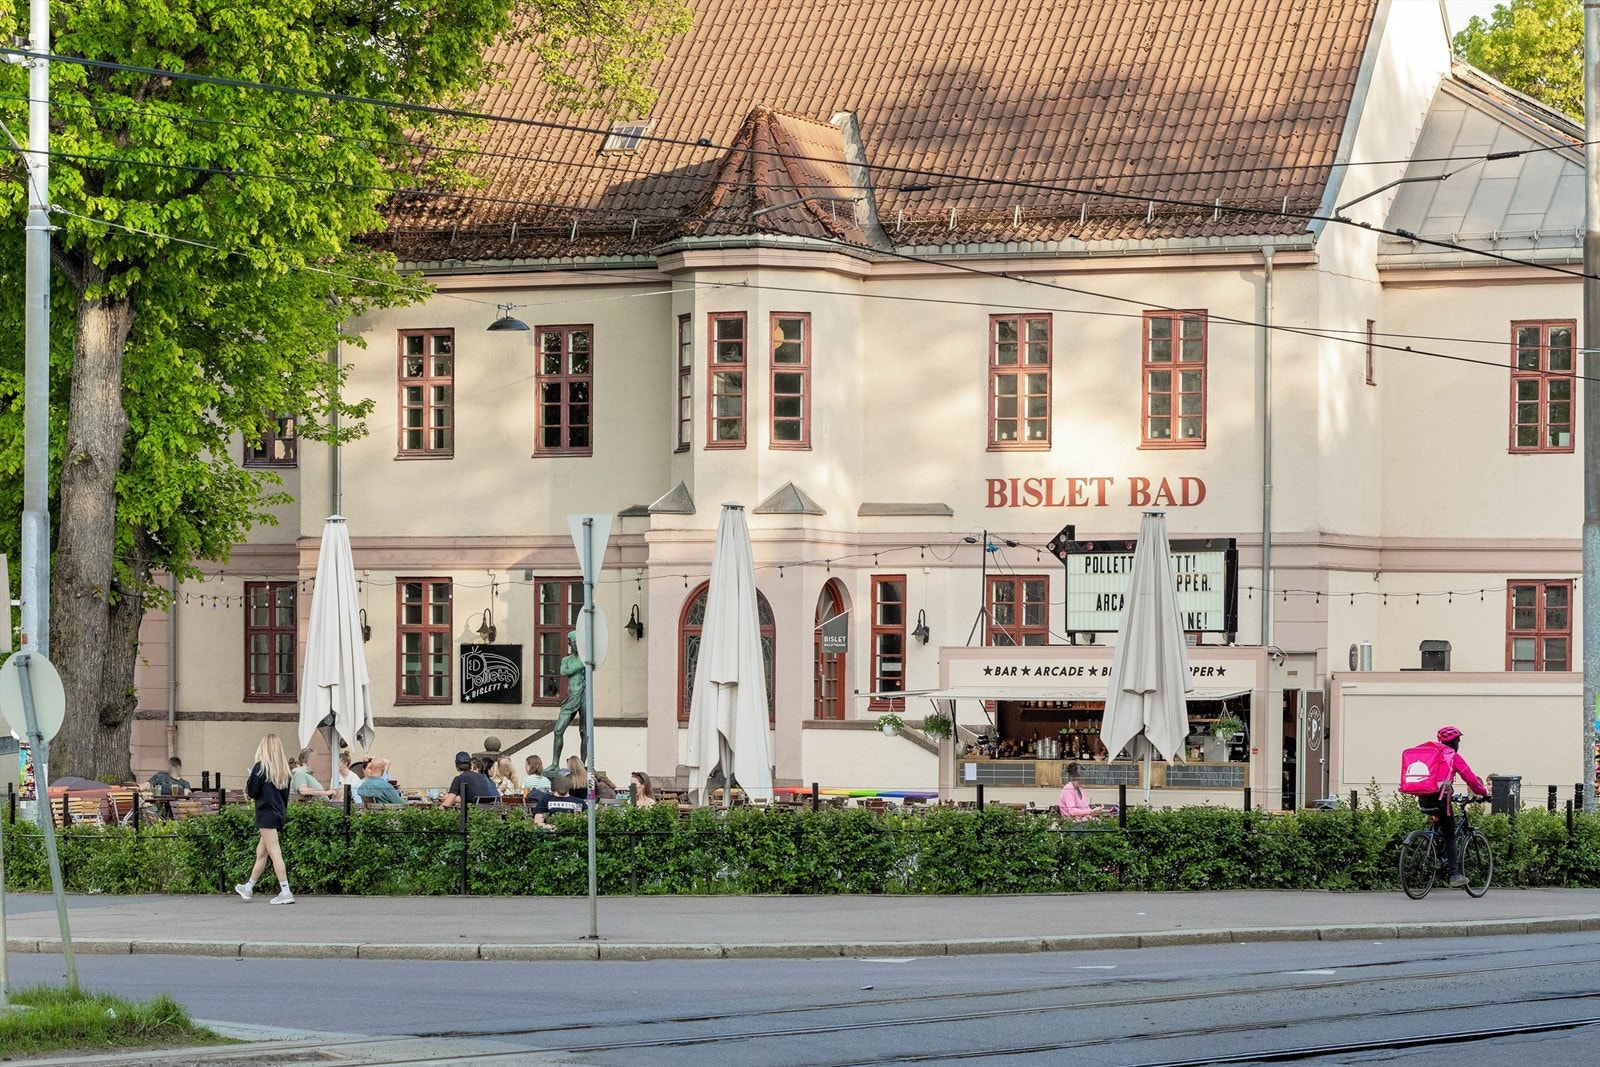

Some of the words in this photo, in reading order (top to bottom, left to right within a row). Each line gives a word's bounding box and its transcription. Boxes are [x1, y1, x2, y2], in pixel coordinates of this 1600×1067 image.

[985, 477, 1114, 508] BISLET
[1128, 477, 1206, 507] BAD
[1176, 574, 1211, 592] PPER.
[1096, 594, 1125, 611] ARCA
[994, 666, 1017, 677] BAR
[1034, 666, 1084, 677] ARCADE
[471, 682, 502, 698] BISLETT
